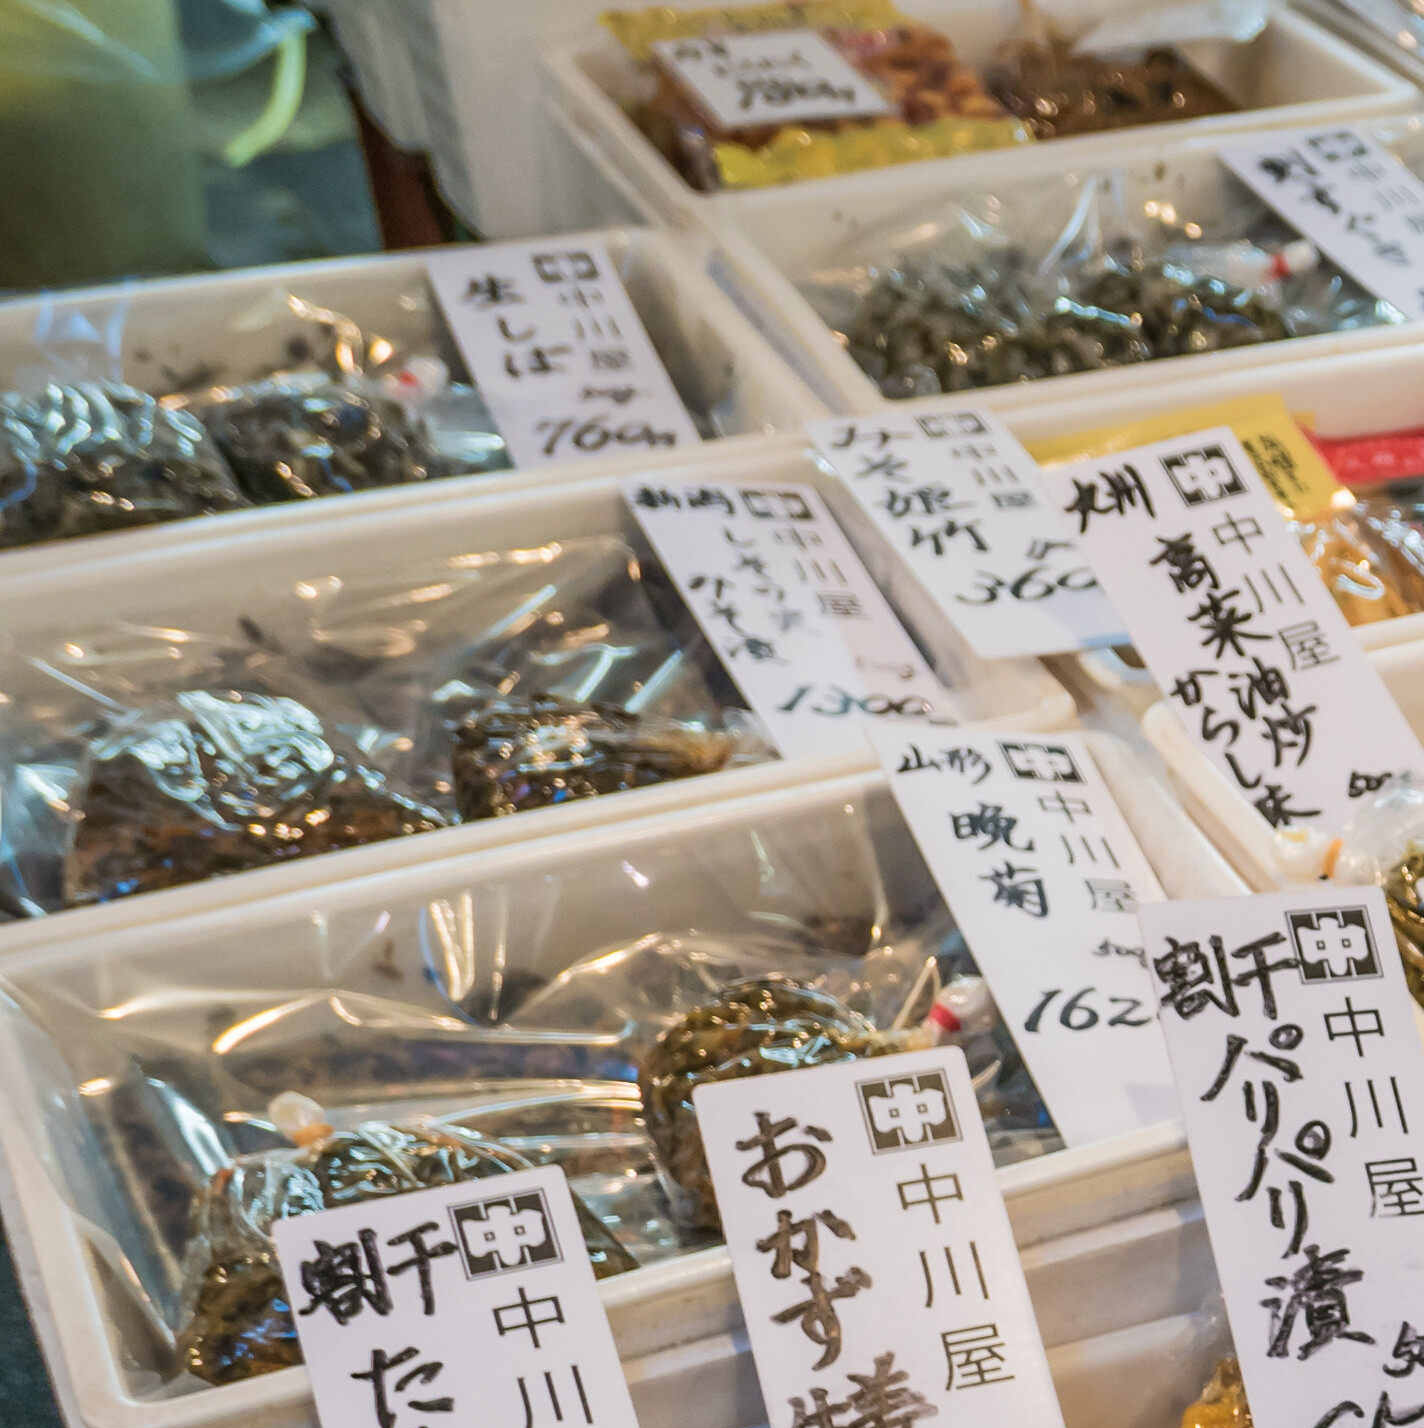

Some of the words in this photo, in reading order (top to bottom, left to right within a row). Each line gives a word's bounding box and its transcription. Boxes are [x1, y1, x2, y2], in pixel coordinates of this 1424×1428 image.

[1065, 464, 1155, 533] 九州
[772, 525, 868, 620] 中川屋
[1212, 512, 1340, 670] 中川屋
[895, 743, 992, 784] 山形
[948, 801, 1049, 918] 晩菊
[1036, 791, 1140, 913] 中川屋
[1200, 1023, 1376, 1361] パリパリ漬
[897, 1164, 1015, 1392] 中川屋
